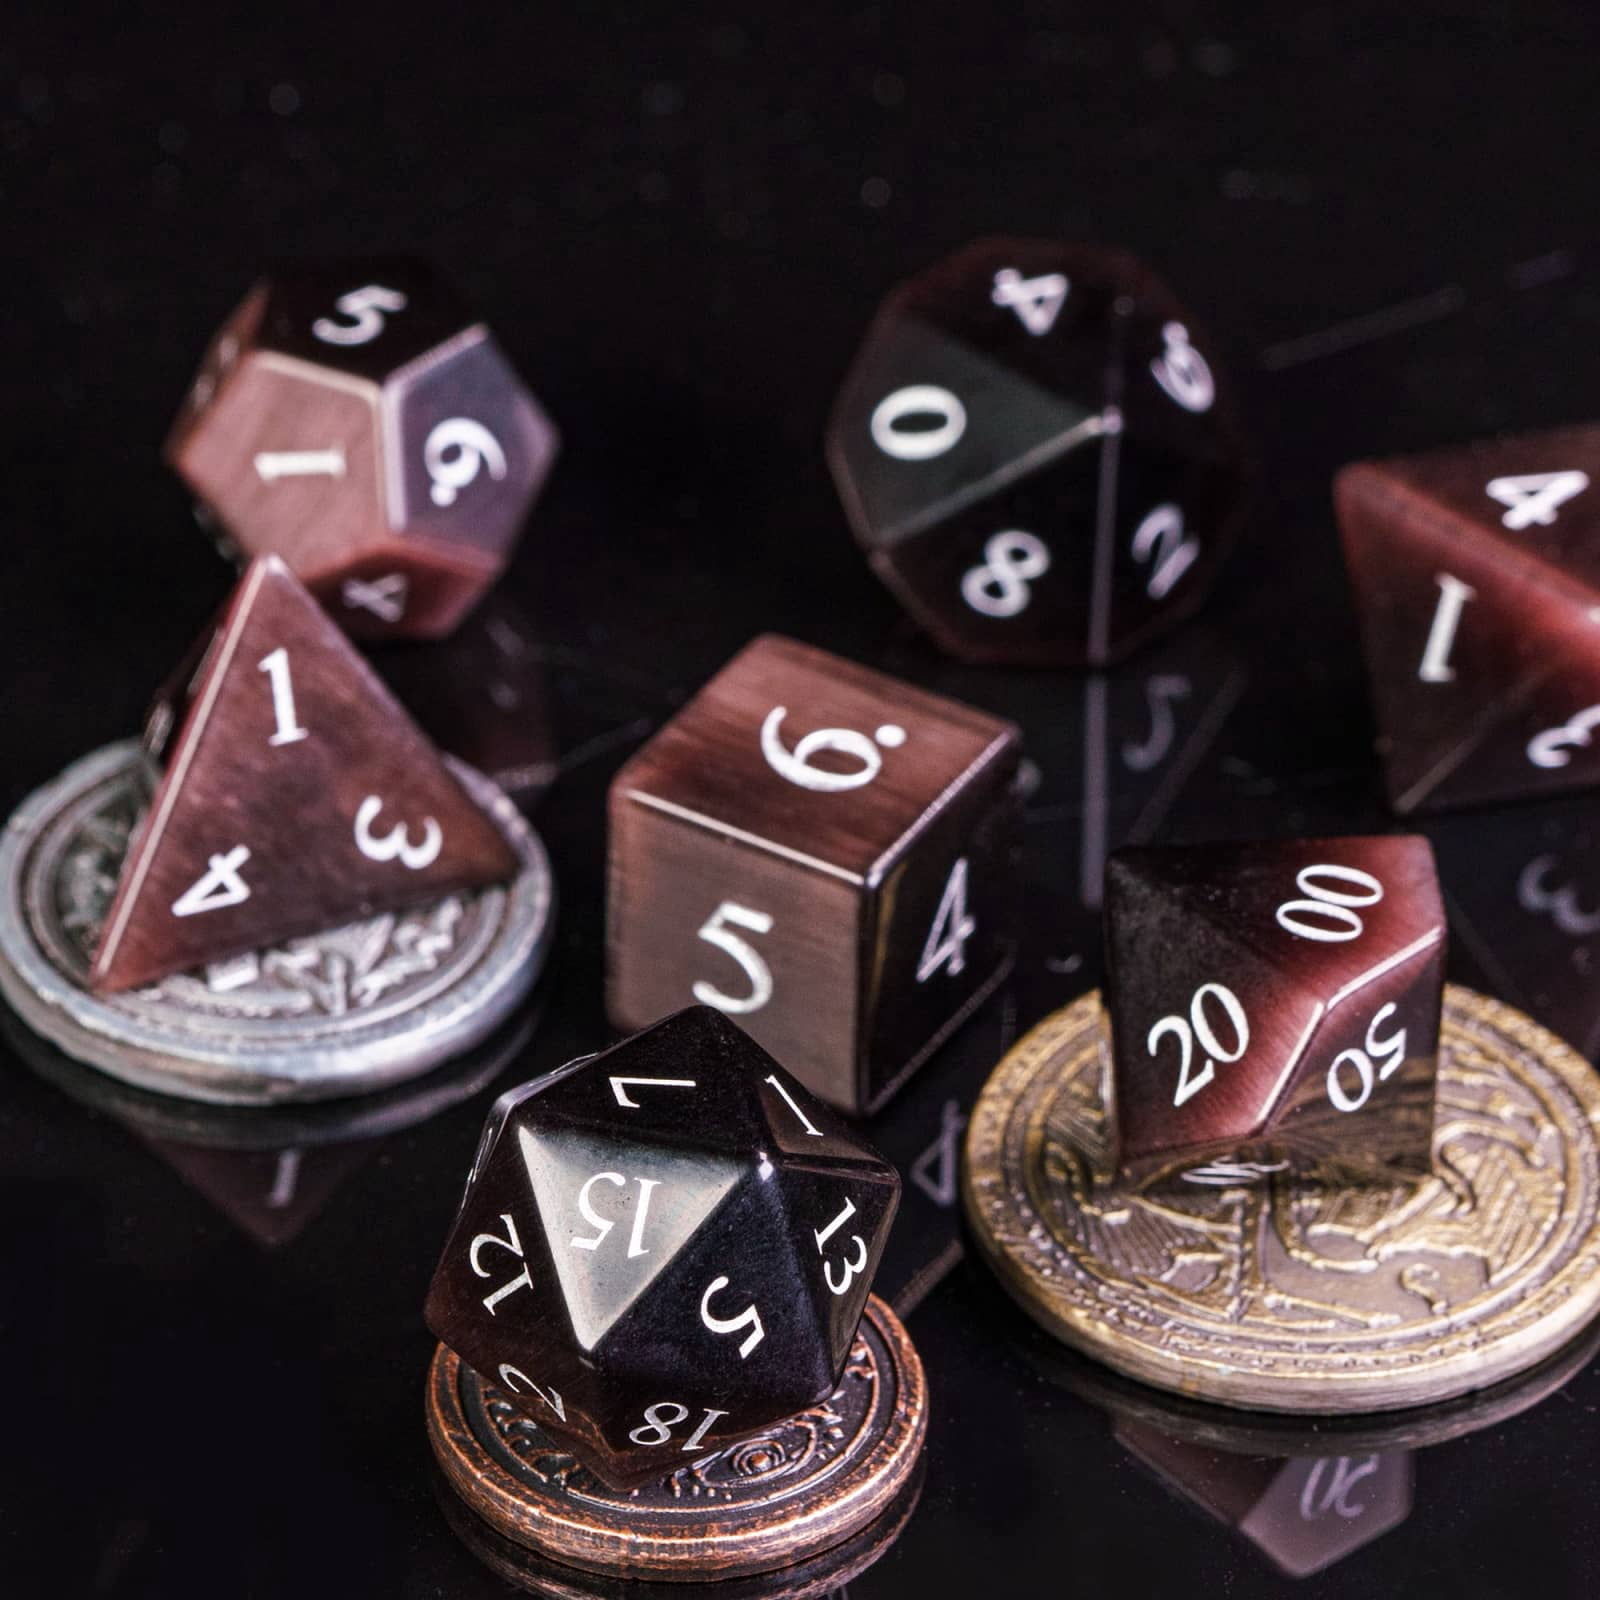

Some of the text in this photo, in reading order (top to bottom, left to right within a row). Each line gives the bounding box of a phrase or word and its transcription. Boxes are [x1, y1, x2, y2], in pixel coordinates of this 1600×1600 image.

[313, 285, 407, 345] 5
[992, 267, 1069, 335] 4
[870, 384, 967, 460] 0
[254, 448, 346, 481] 1
[1486, 469, 1589, 530] 4
[961, 530, 1050, 618] 8
[1131, 504, 1198, 598] 2
[1417, 572, 1475, 683] 1
[258, 647, 307, 747] 1
[354, 794, 443, 869] 3
[171, 844, 251, 917] 4
[916, 857, 975, 982] 4
[1276, 864, 1385, 943] 00
[692, 901, 773, 1014] 5
[1147, 983, 1250, 1107] 20
[1326, 1001, 1408, 1113] 50
[608, 1076, 697, 1108] 7
[764, 1074, 824, 1137] 1
[569, 1170, 662, 1259] 15
[813, 1196, 868, 1296] 13
[468, 1214, 535, 1317] 12
[700, 1275, 766, 1359] 5
[499, 1362, 567, 1423] 2
[628, 1402, 730, 1452] 18
